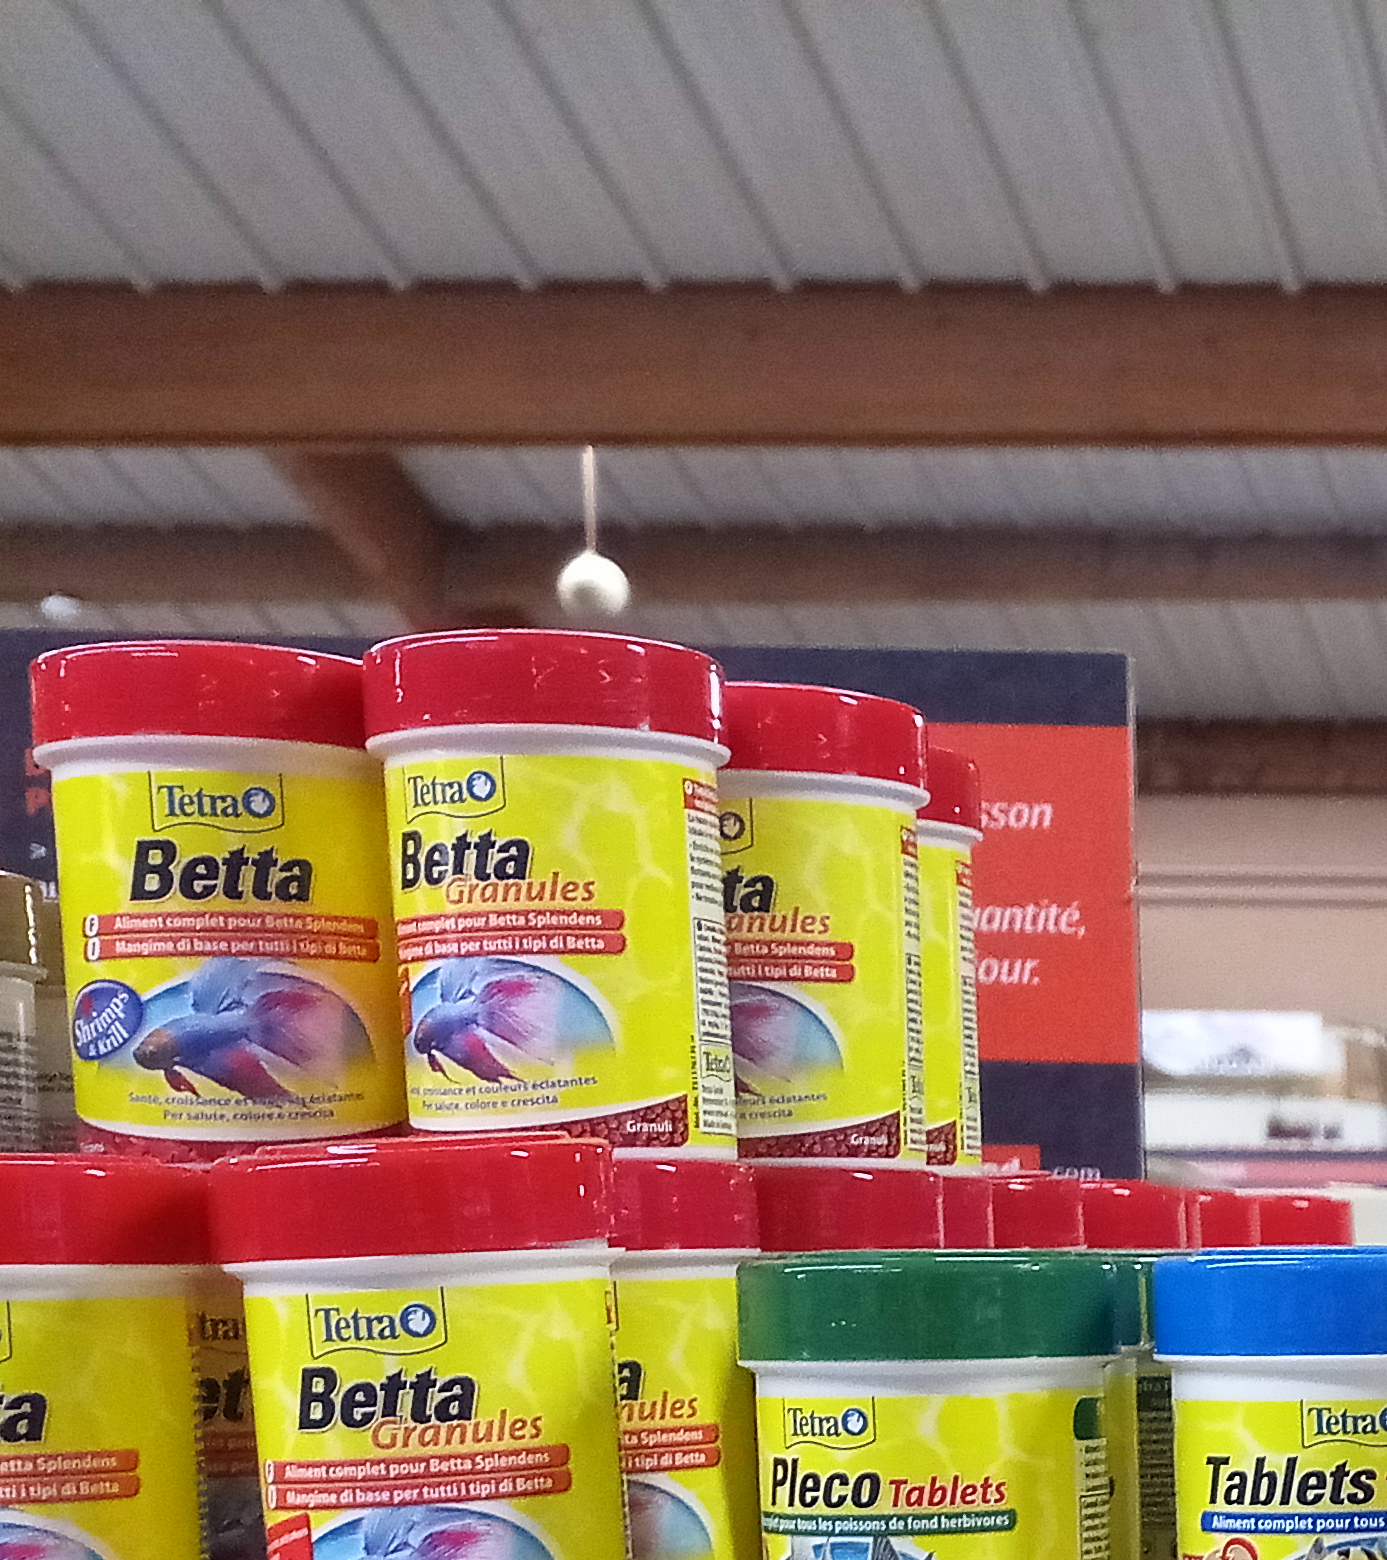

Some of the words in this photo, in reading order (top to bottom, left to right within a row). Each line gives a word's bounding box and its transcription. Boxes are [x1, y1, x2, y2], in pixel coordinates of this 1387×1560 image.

[158, 785, 243, 817] Tetra
[408, 774, 467, 808] Tetra
[130, 838, 314, 902] Betta
[401, 829, 532, 891] Betta
[445, 872, 596, 905] Granules
[978, 958, 1040, 986] our.
[75, 989, 130, 1047] Shrimps
[627, 1120, 672, 1133] Granuli
[314, 1307, 400, 1343] Tetra
[298, 1365, 480, 1432] Betta
[371, 1409, 544, 1451] Granules
[788, 1407, 841, 1438] Tetra
[1308, 1406, 1378, 1436] Tetra
[284, 1464, 326, 1479] Aliment
[329, 1462, 386, 1479] complet
[390, 1461, 426, 1478] pour
[429, 1457, 472, 1473] Betta
[474, 1450, 550, 1472] Splendens
[1206, 1455, 1377, 1507] Tablets
[771, 1456, 881, 1510] Pleco
[889, 1476, 1007, 1508] Tablets
[817, 1517, 832, 1530] les
[834, 1516, 886, 1533] poissons
[889, 1515, 905, 1529] de
[907, 1514, 938, 1529] fond
[940, 1512, 1009, 1528] herbivores
[1212, 1516, 1255, 1530] Aliment
[1258, 1516, 1313, 1532] complet
[1316, 1516, 1350, 1532] pour
[1353, 1515, 1385, 1529] tous
